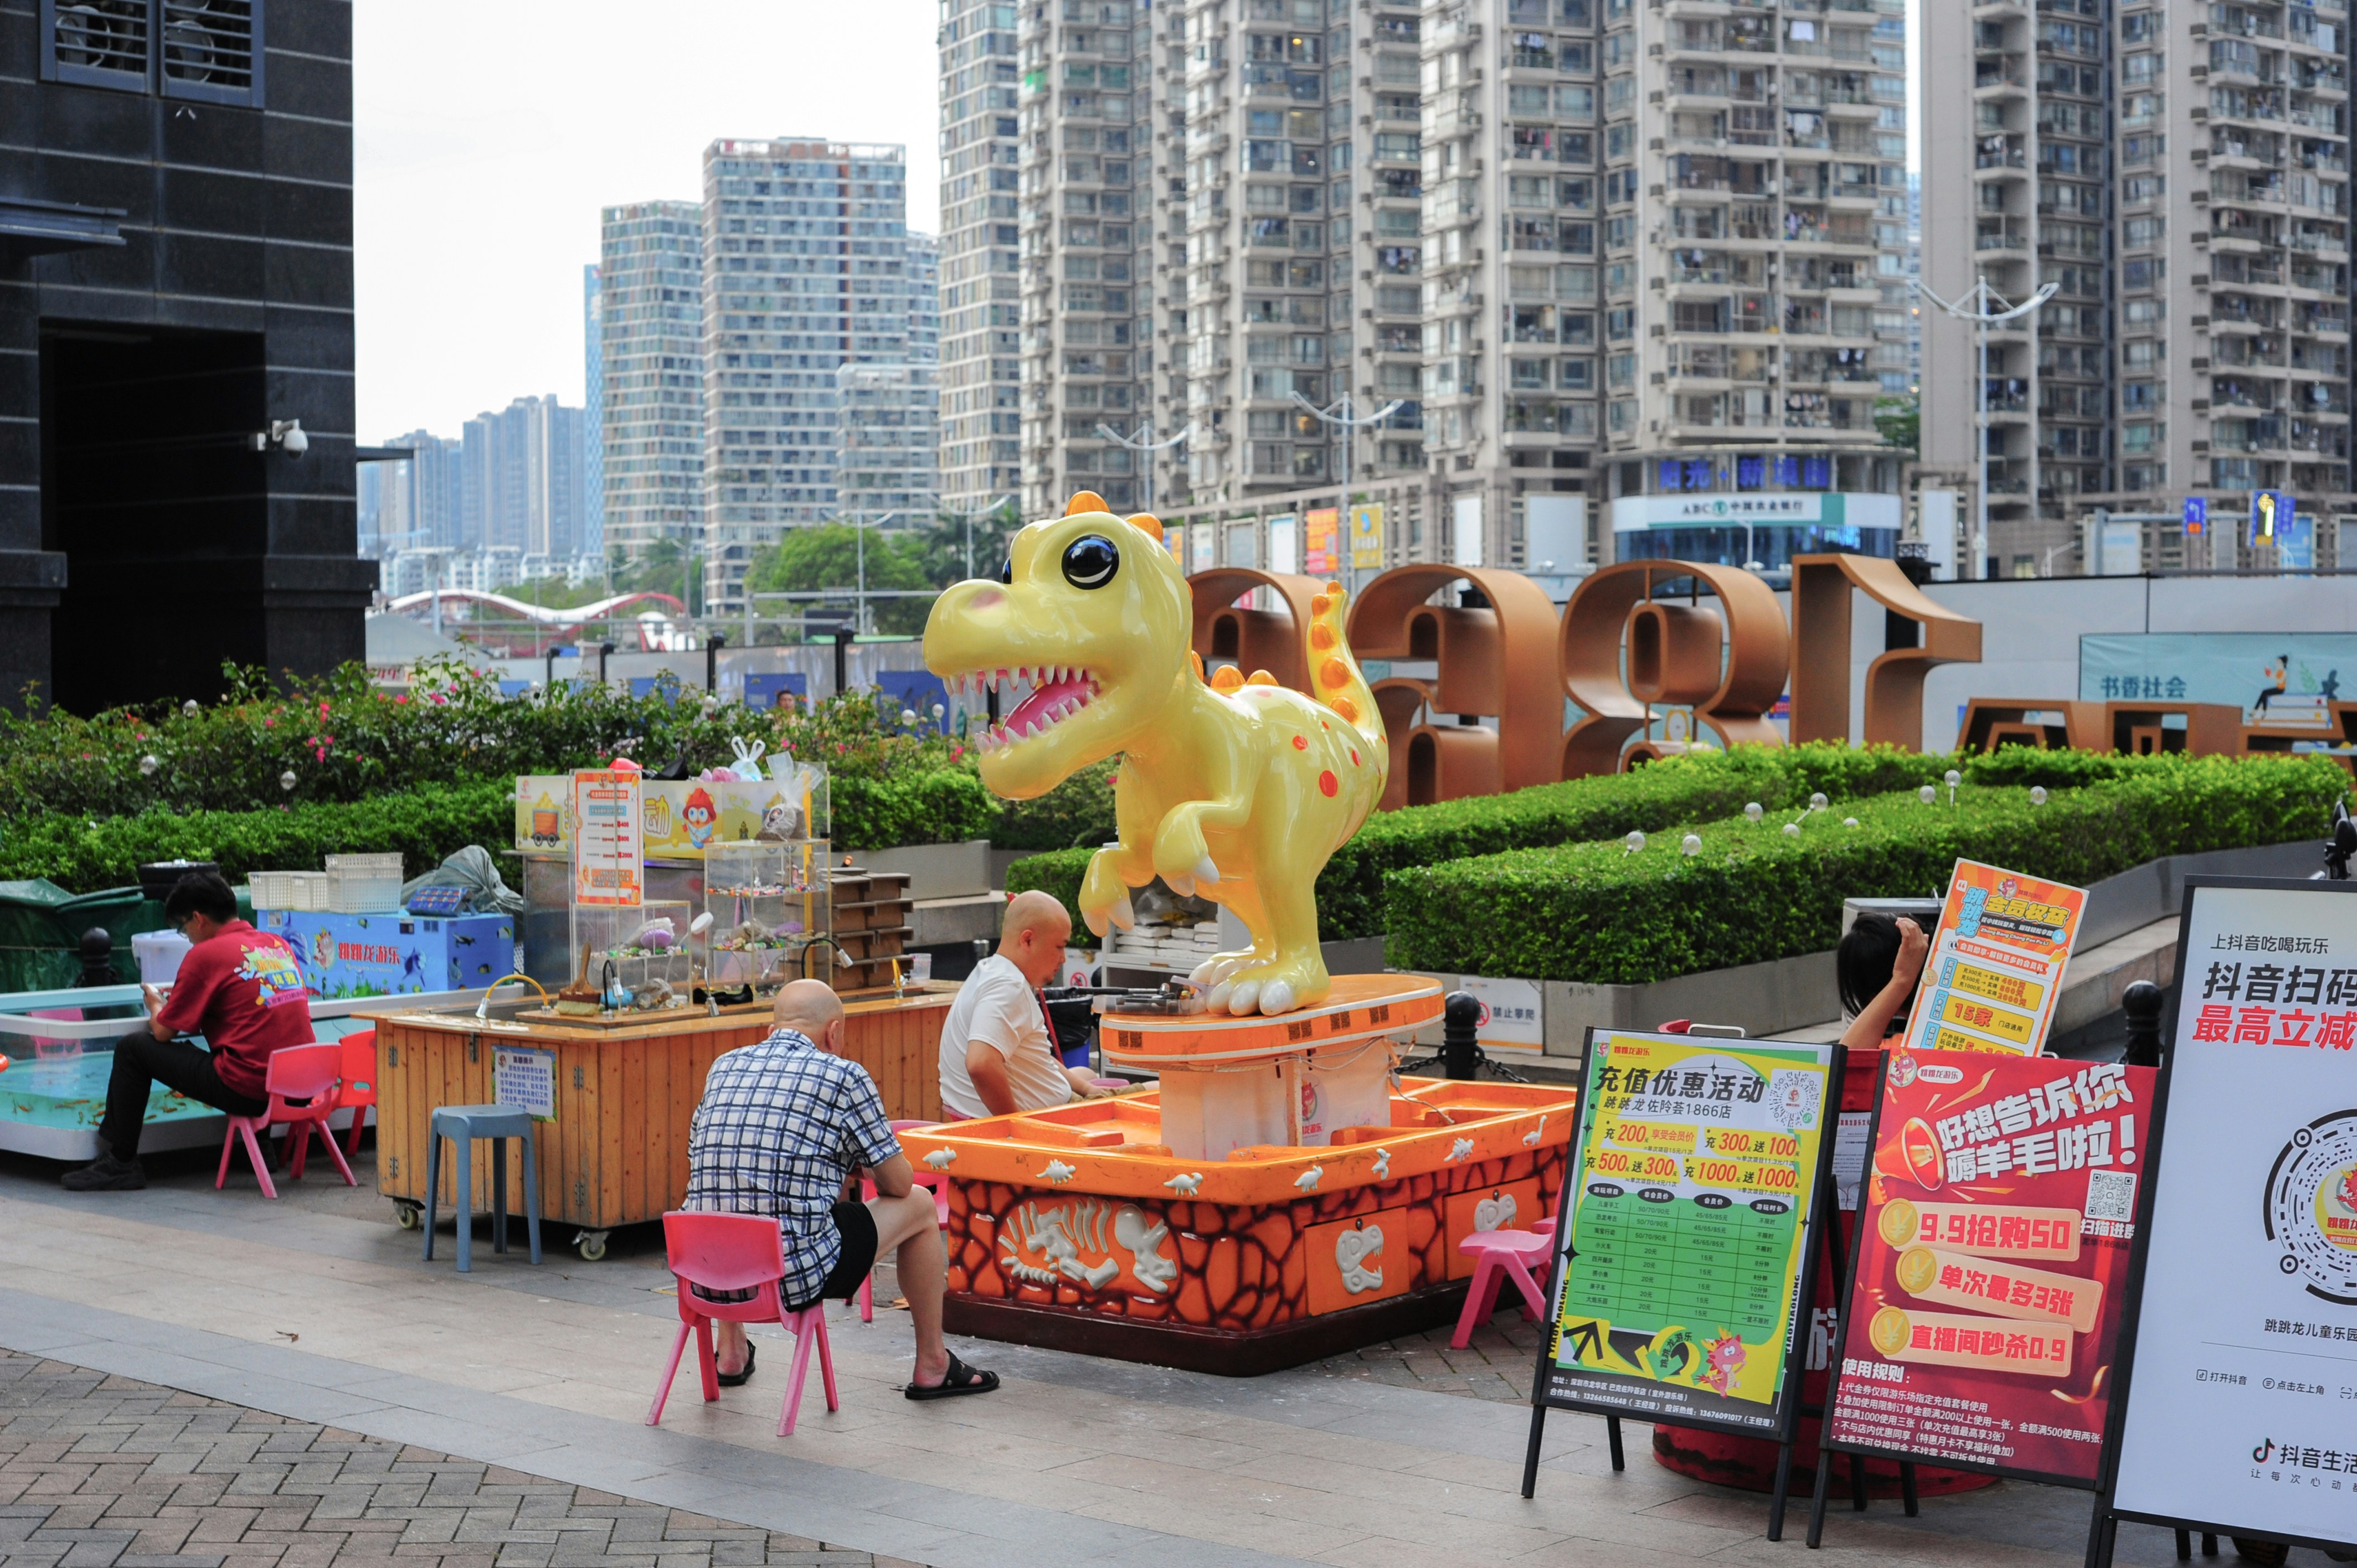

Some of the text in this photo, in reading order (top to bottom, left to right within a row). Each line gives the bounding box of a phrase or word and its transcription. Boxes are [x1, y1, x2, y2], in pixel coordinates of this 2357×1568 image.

[1731, 500, 1803, 511] 中国农业银行
[2101, 675, 2187, 699] 书香社会
[1984, 896, 2071, 928] 会员权益
[338, 942, 400, 965] 跳跳龙游乐
[2210, 933, 2329, 955] 上抖音吃喝玩乐
[2202, 961, 2357, 1007] 抖音扫码
[1493, 1007, 1535, 1020] 禁止攀爬
[2192, 1004, 2357, 1051] 最高立减
[1593, 1066, 1765, 1103] 充值优惠活动
[1920, 1069, 1959, 1080] 跳跳龙游乐
[1936, 1063, 2134, 1152] 好想告诉你
[1593, 1187, 1783, 1212] 游玩项目 非会员价 会员价 游玩时长
[1638, 1206, 1670, 1215] 50/70/90元
[1696, 1213, 1728, 1221] 45/65/85元
[1637, 1219, 1669, 1227] 50/70/90元
[1694, 1225, 1726, 1234] 45/65/85元
[1919, 1213, 2071, 1250] 9.9抢购50
[2080, 1219, 2135, 1239] 扫描进群
[1635, 1233, 1667, 1241] 50/70/90元
[1692, 1239, 1725, 1248] 45/65/85元
[1939, 1264, 2075, 1317] 单次最多3张
[2264, 1319, 2357, 1342] 跳跳龙儿童乐园
[1910, 1325, 2066, 1362] 直播间秒杀0.9
[2210, 1371, 2324, 1395] 打开抖音 点击左上角
[2279, 1443, 2357, 1474] 抖音生活
